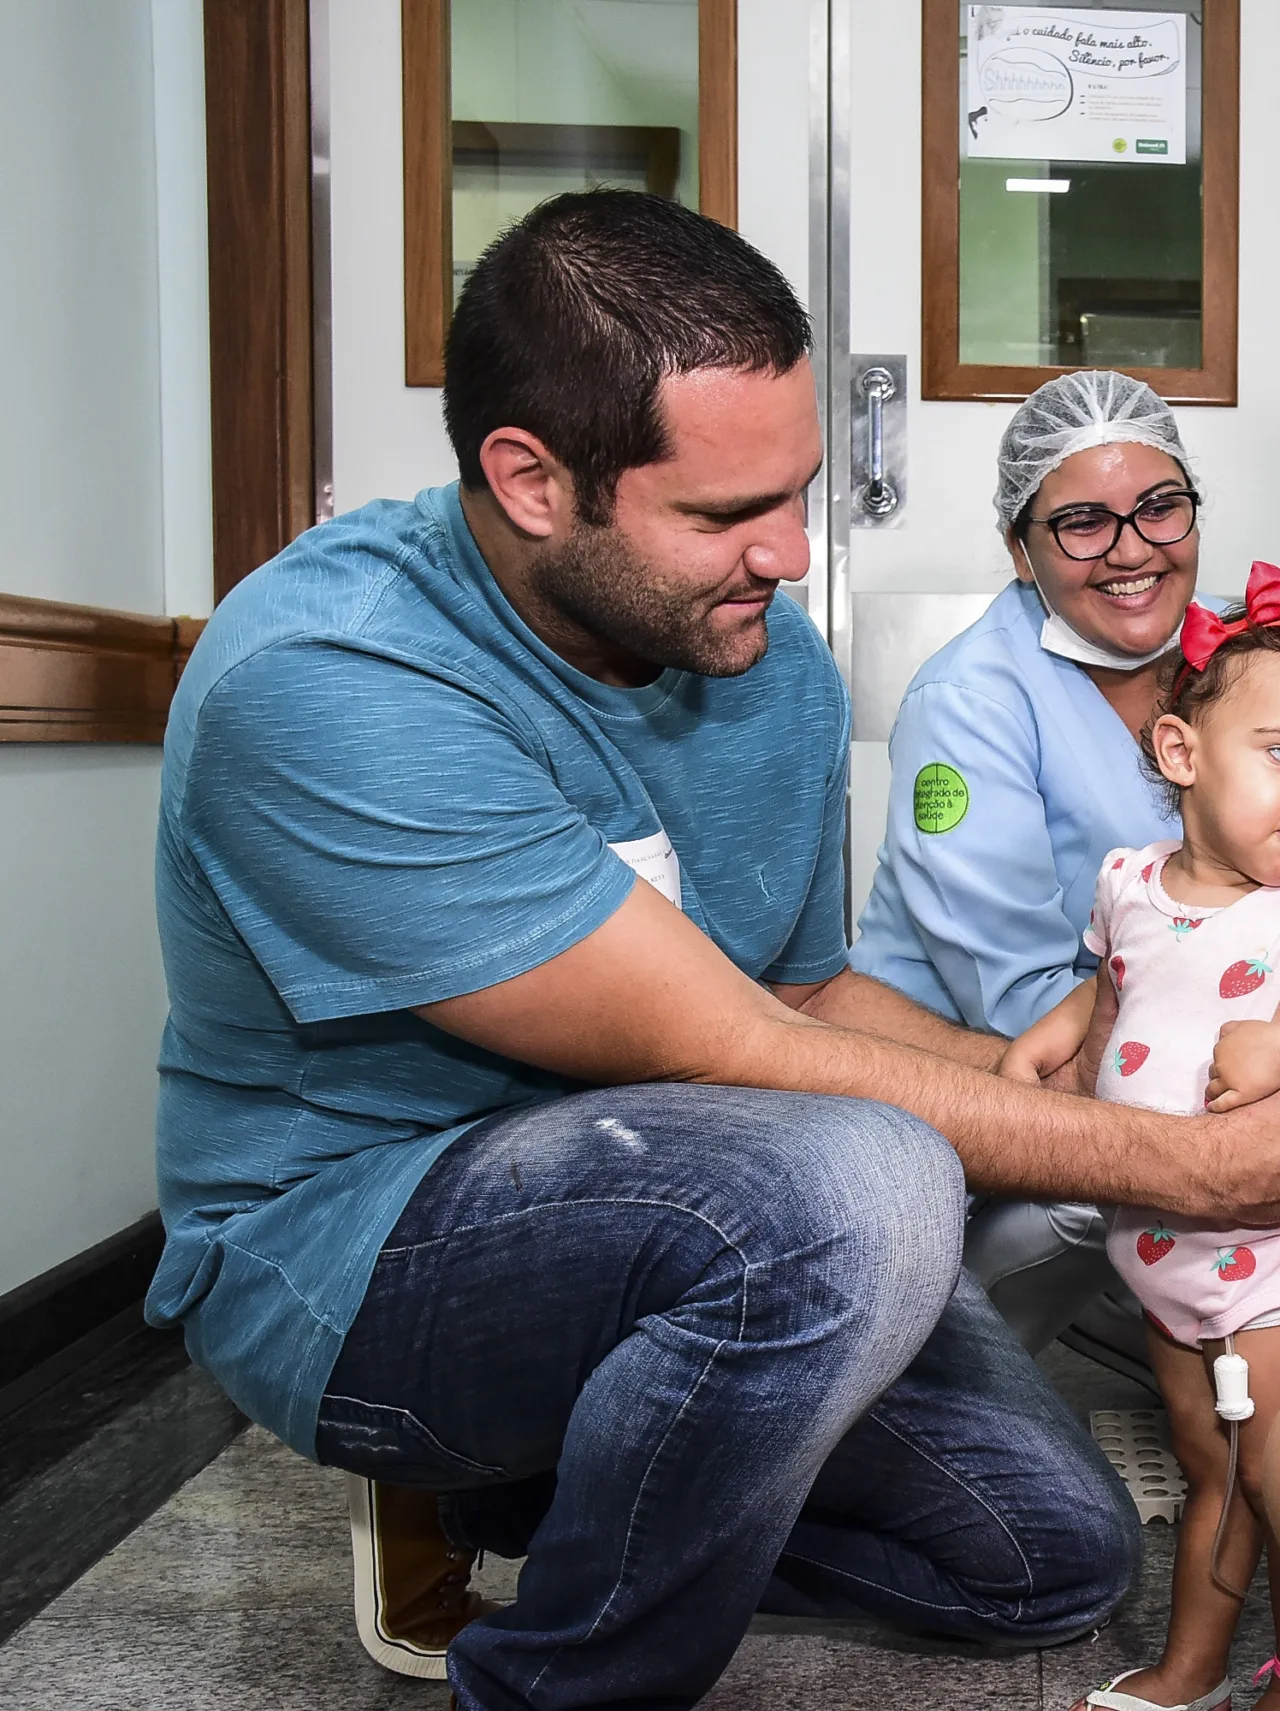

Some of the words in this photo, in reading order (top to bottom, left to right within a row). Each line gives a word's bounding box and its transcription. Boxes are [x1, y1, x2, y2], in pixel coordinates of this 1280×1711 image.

[1032, 25, 1073, 42] cuidado
[1075, 32, 1097, 47] fala
[1099, 38, 1125, 49] mais
[1126, 35, 1152, 49] alto.
[1069, 50, 1116, 68] Silêncio,
[1118, 58, 1137, 71] por
[1138, 52, 1170, 68] favor.
[921, 779, 949, 787] centro
[952, 789, 964, 797] de
[947, 799, 953, 809] à
